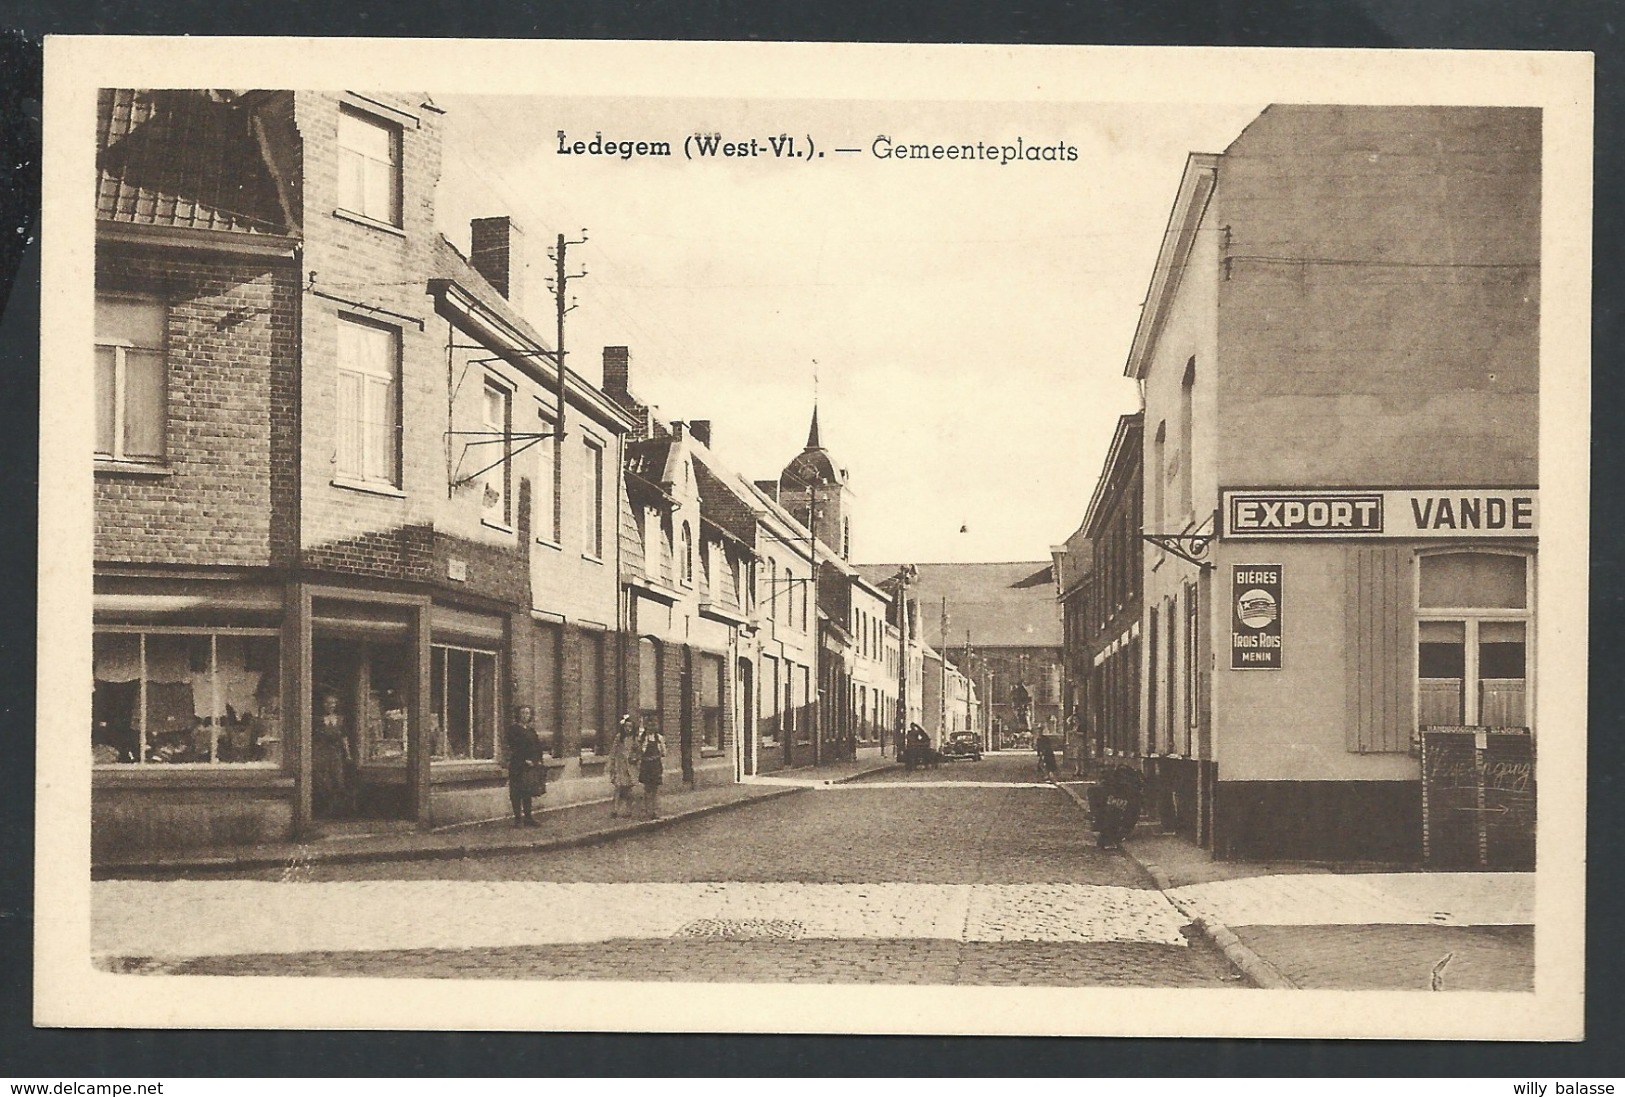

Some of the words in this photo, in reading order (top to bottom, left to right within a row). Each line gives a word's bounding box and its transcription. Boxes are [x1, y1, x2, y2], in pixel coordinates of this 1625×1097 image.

[1237, 501, 1377, 528] EXPORT
[1411, 496, 1533, 530] VANDE
[1242, 652, 1271, 661] MENIN
